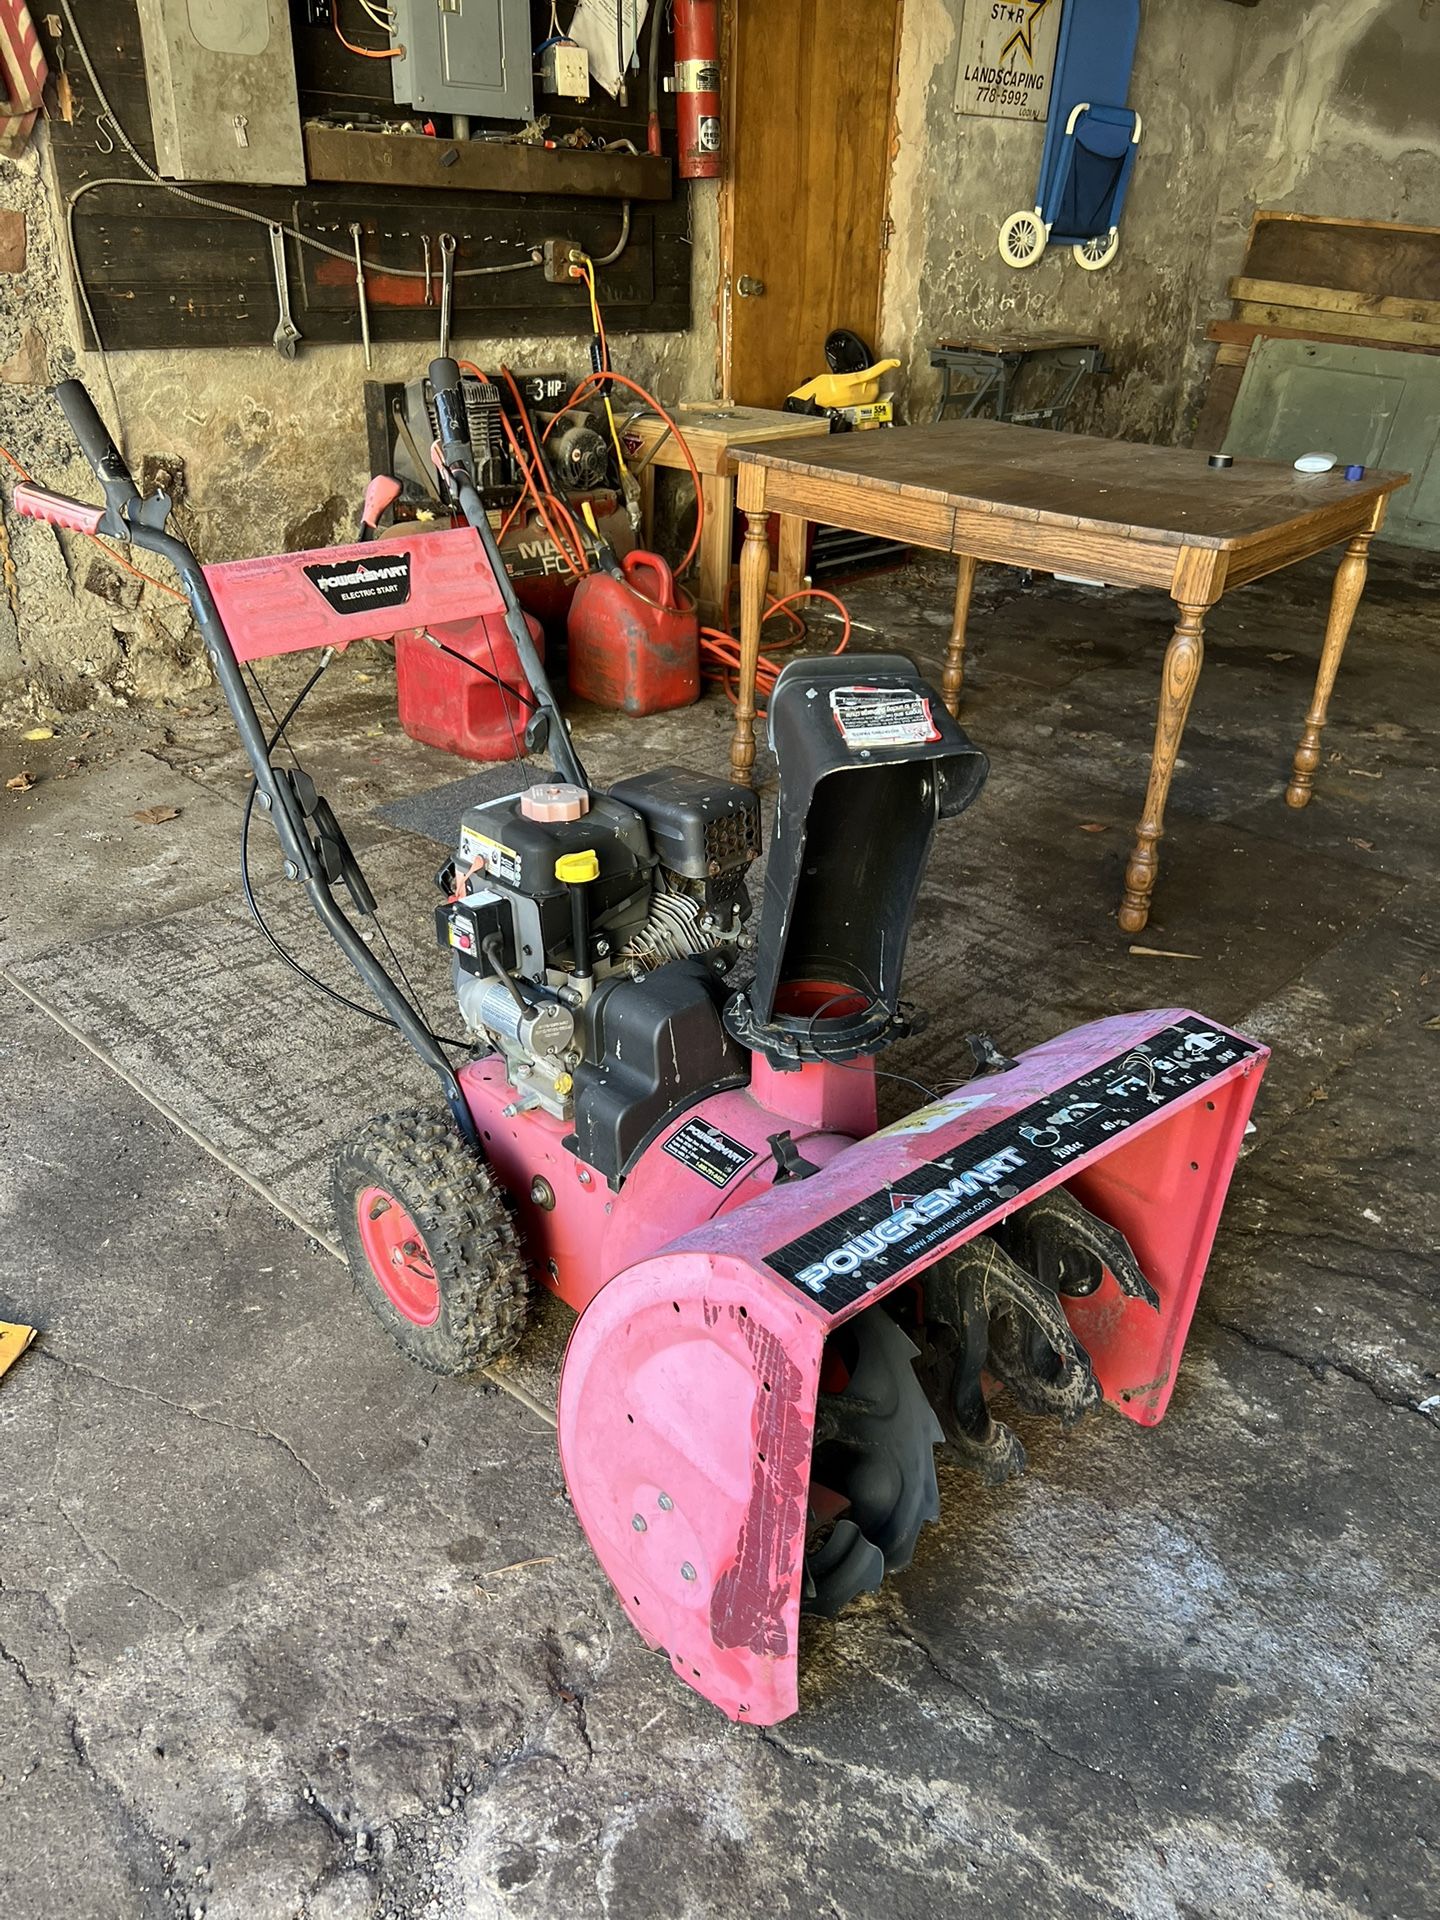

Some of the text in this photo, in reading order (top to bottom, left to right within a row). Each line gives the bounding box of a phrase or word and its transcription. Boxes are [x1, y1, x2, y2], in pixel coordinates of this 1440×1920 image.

[964, 65, 1045, 90] LANDSCAPING
[976, 87, 1028, 106] 778-5992
[533, 378, 562, 401] 3 HP
[317, 565, 408, 590] POWERSMART
[341, 584, 399, 601] ELECTRIC START
[685, 1124, 745, 1163] POWERSMART
[1053, 1141, 1084, 1159] 208cc
[795, 1145, 1027, 1293] POWERSMART
[903, 1197, 993, 1256] www.amerisuninc.com
